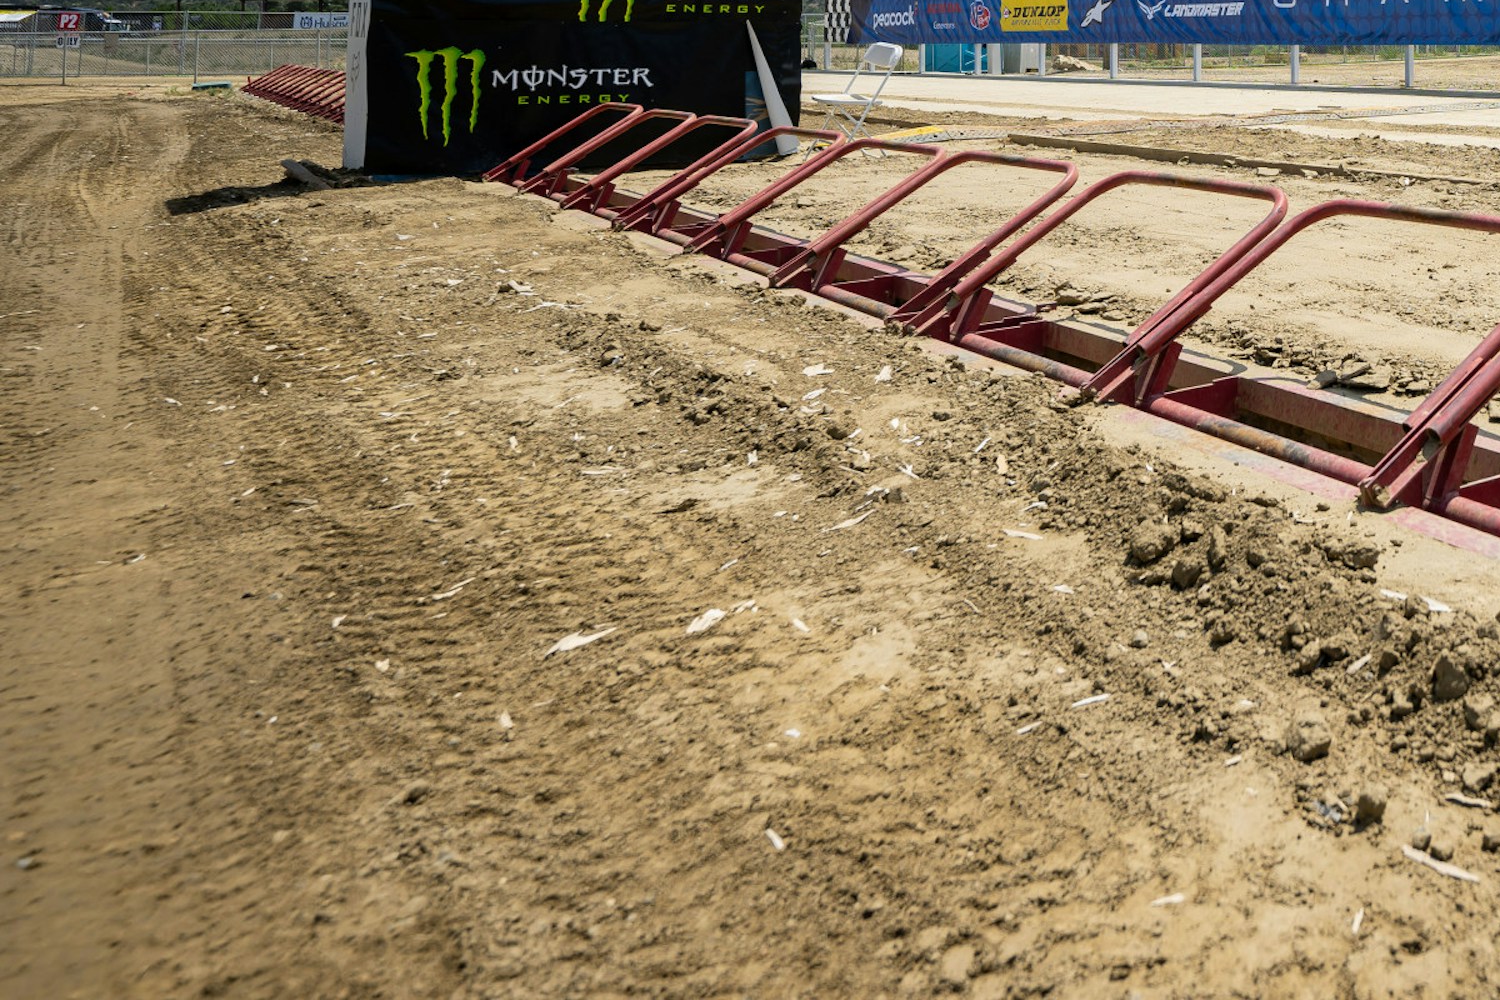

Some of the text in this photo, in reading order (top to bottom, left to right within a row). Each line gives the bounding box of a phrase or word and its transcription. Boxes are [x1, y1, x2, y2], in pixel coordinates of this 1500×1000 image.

[666, 3, 766, 14] ENERGY
[1012, 5, 1065, 18] DUNLOP
[1164, 1, 1244, 17] LANDMASTER
[59, 14, 78, 29] P2
[873, 5, 914, 31] peacock
[57, 36, 78, 46] OLY
[491, 65, 654, 91] MONSTER
[517, 94, 630, 105] ENERGY
